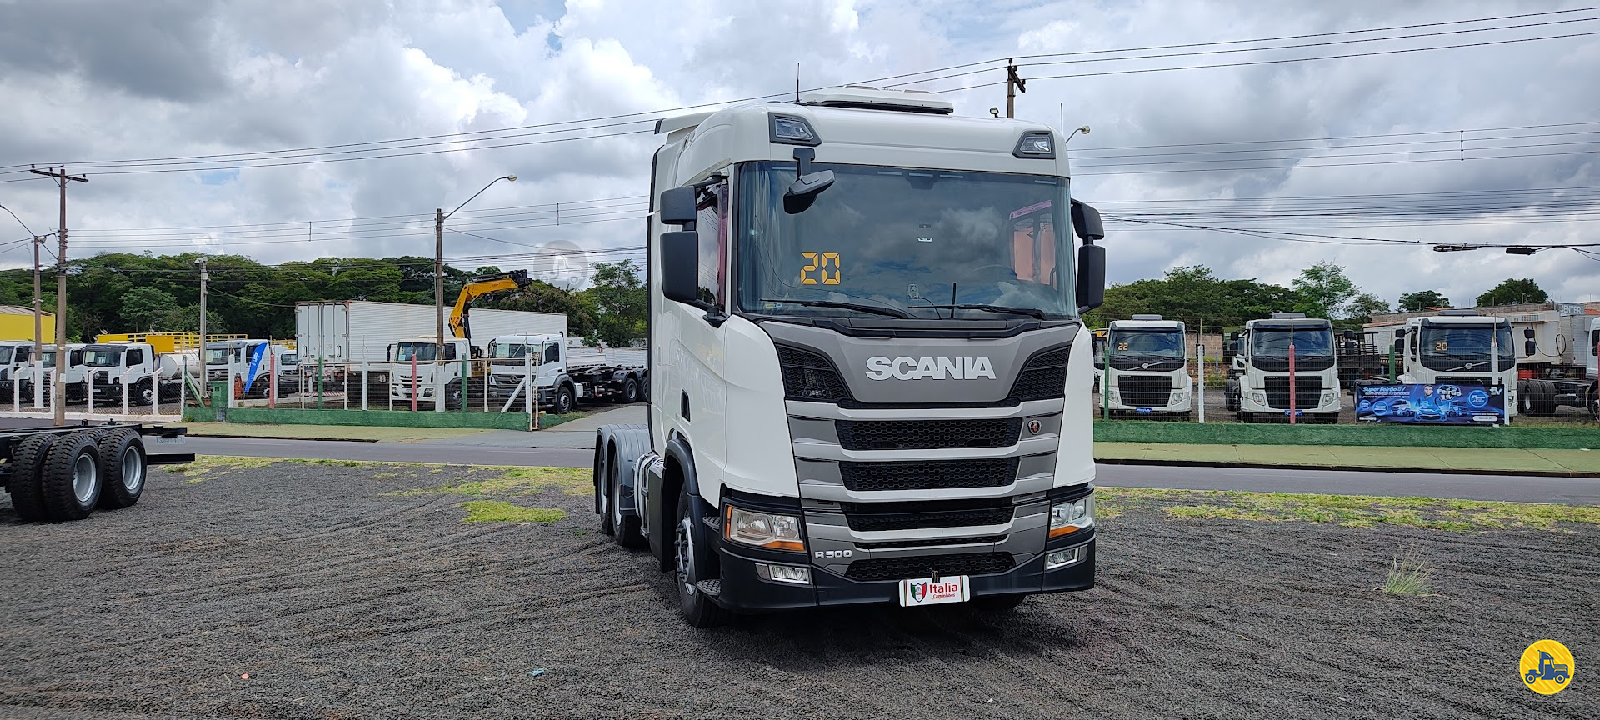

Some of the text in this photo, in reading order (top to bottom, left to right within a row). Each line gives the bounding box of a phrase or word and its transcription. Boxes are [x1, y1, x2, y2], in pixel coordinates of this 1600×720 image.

[800, 252, 841, 285] 20
[1118, 342, 1128, 350] 22
[1435, 342, 1447, 351] 20
[866, 356, 997, 381] SCANIA
[929, 582, 958, 594] Italia
